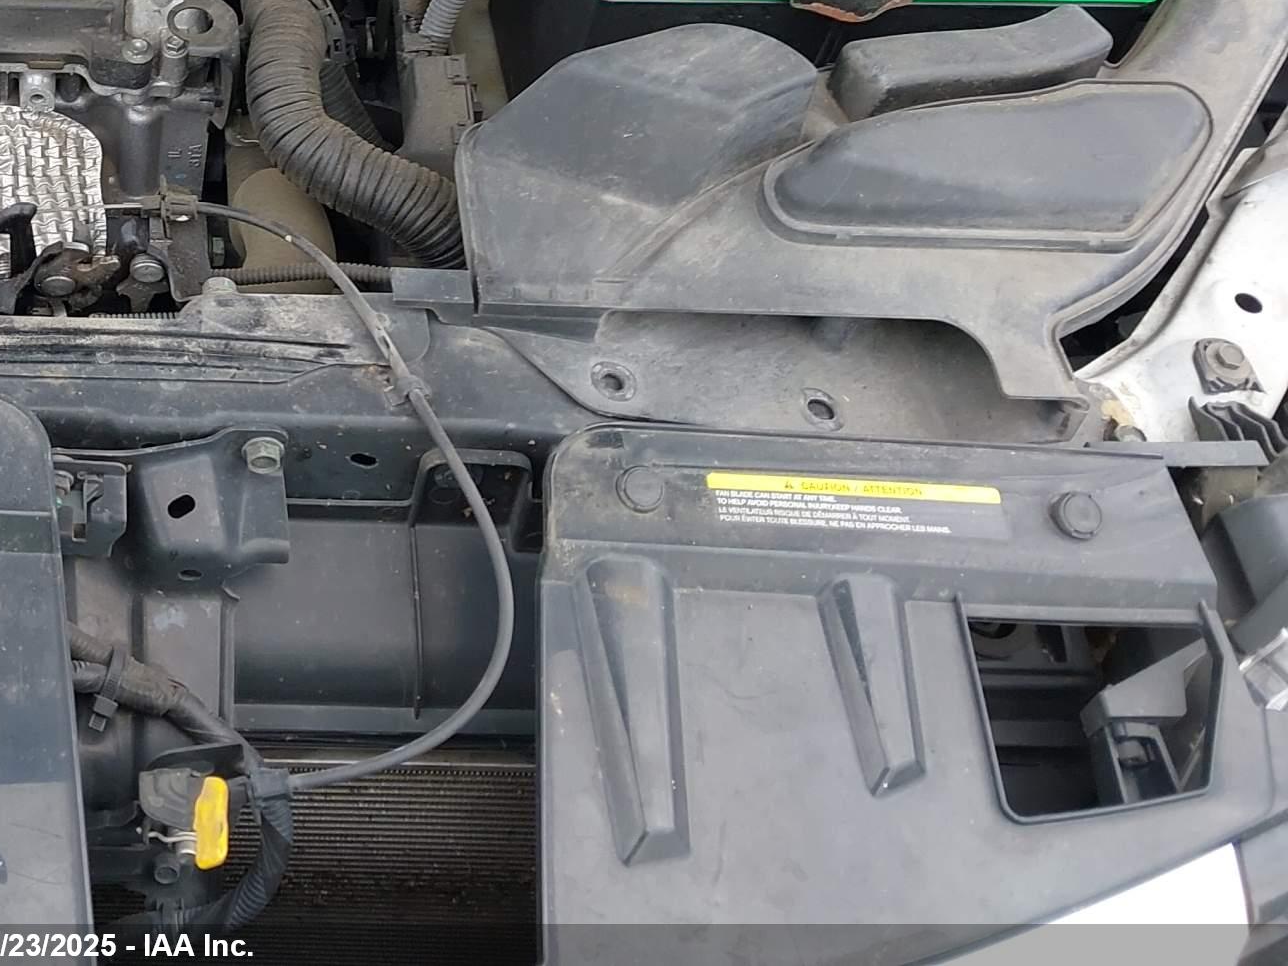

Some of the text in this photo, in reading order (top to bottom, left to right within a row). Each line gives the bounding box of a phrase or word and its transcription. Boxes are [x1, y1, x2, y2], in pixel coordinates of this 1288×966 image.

[800, 481, 850, 493] CAUTION
[863, 485, 923, 497] ATTENTION
[754, 491, 770, 499] CAN
[771, 492, 792, 500] START
[769, 500, 807, 509] PERSONAL
